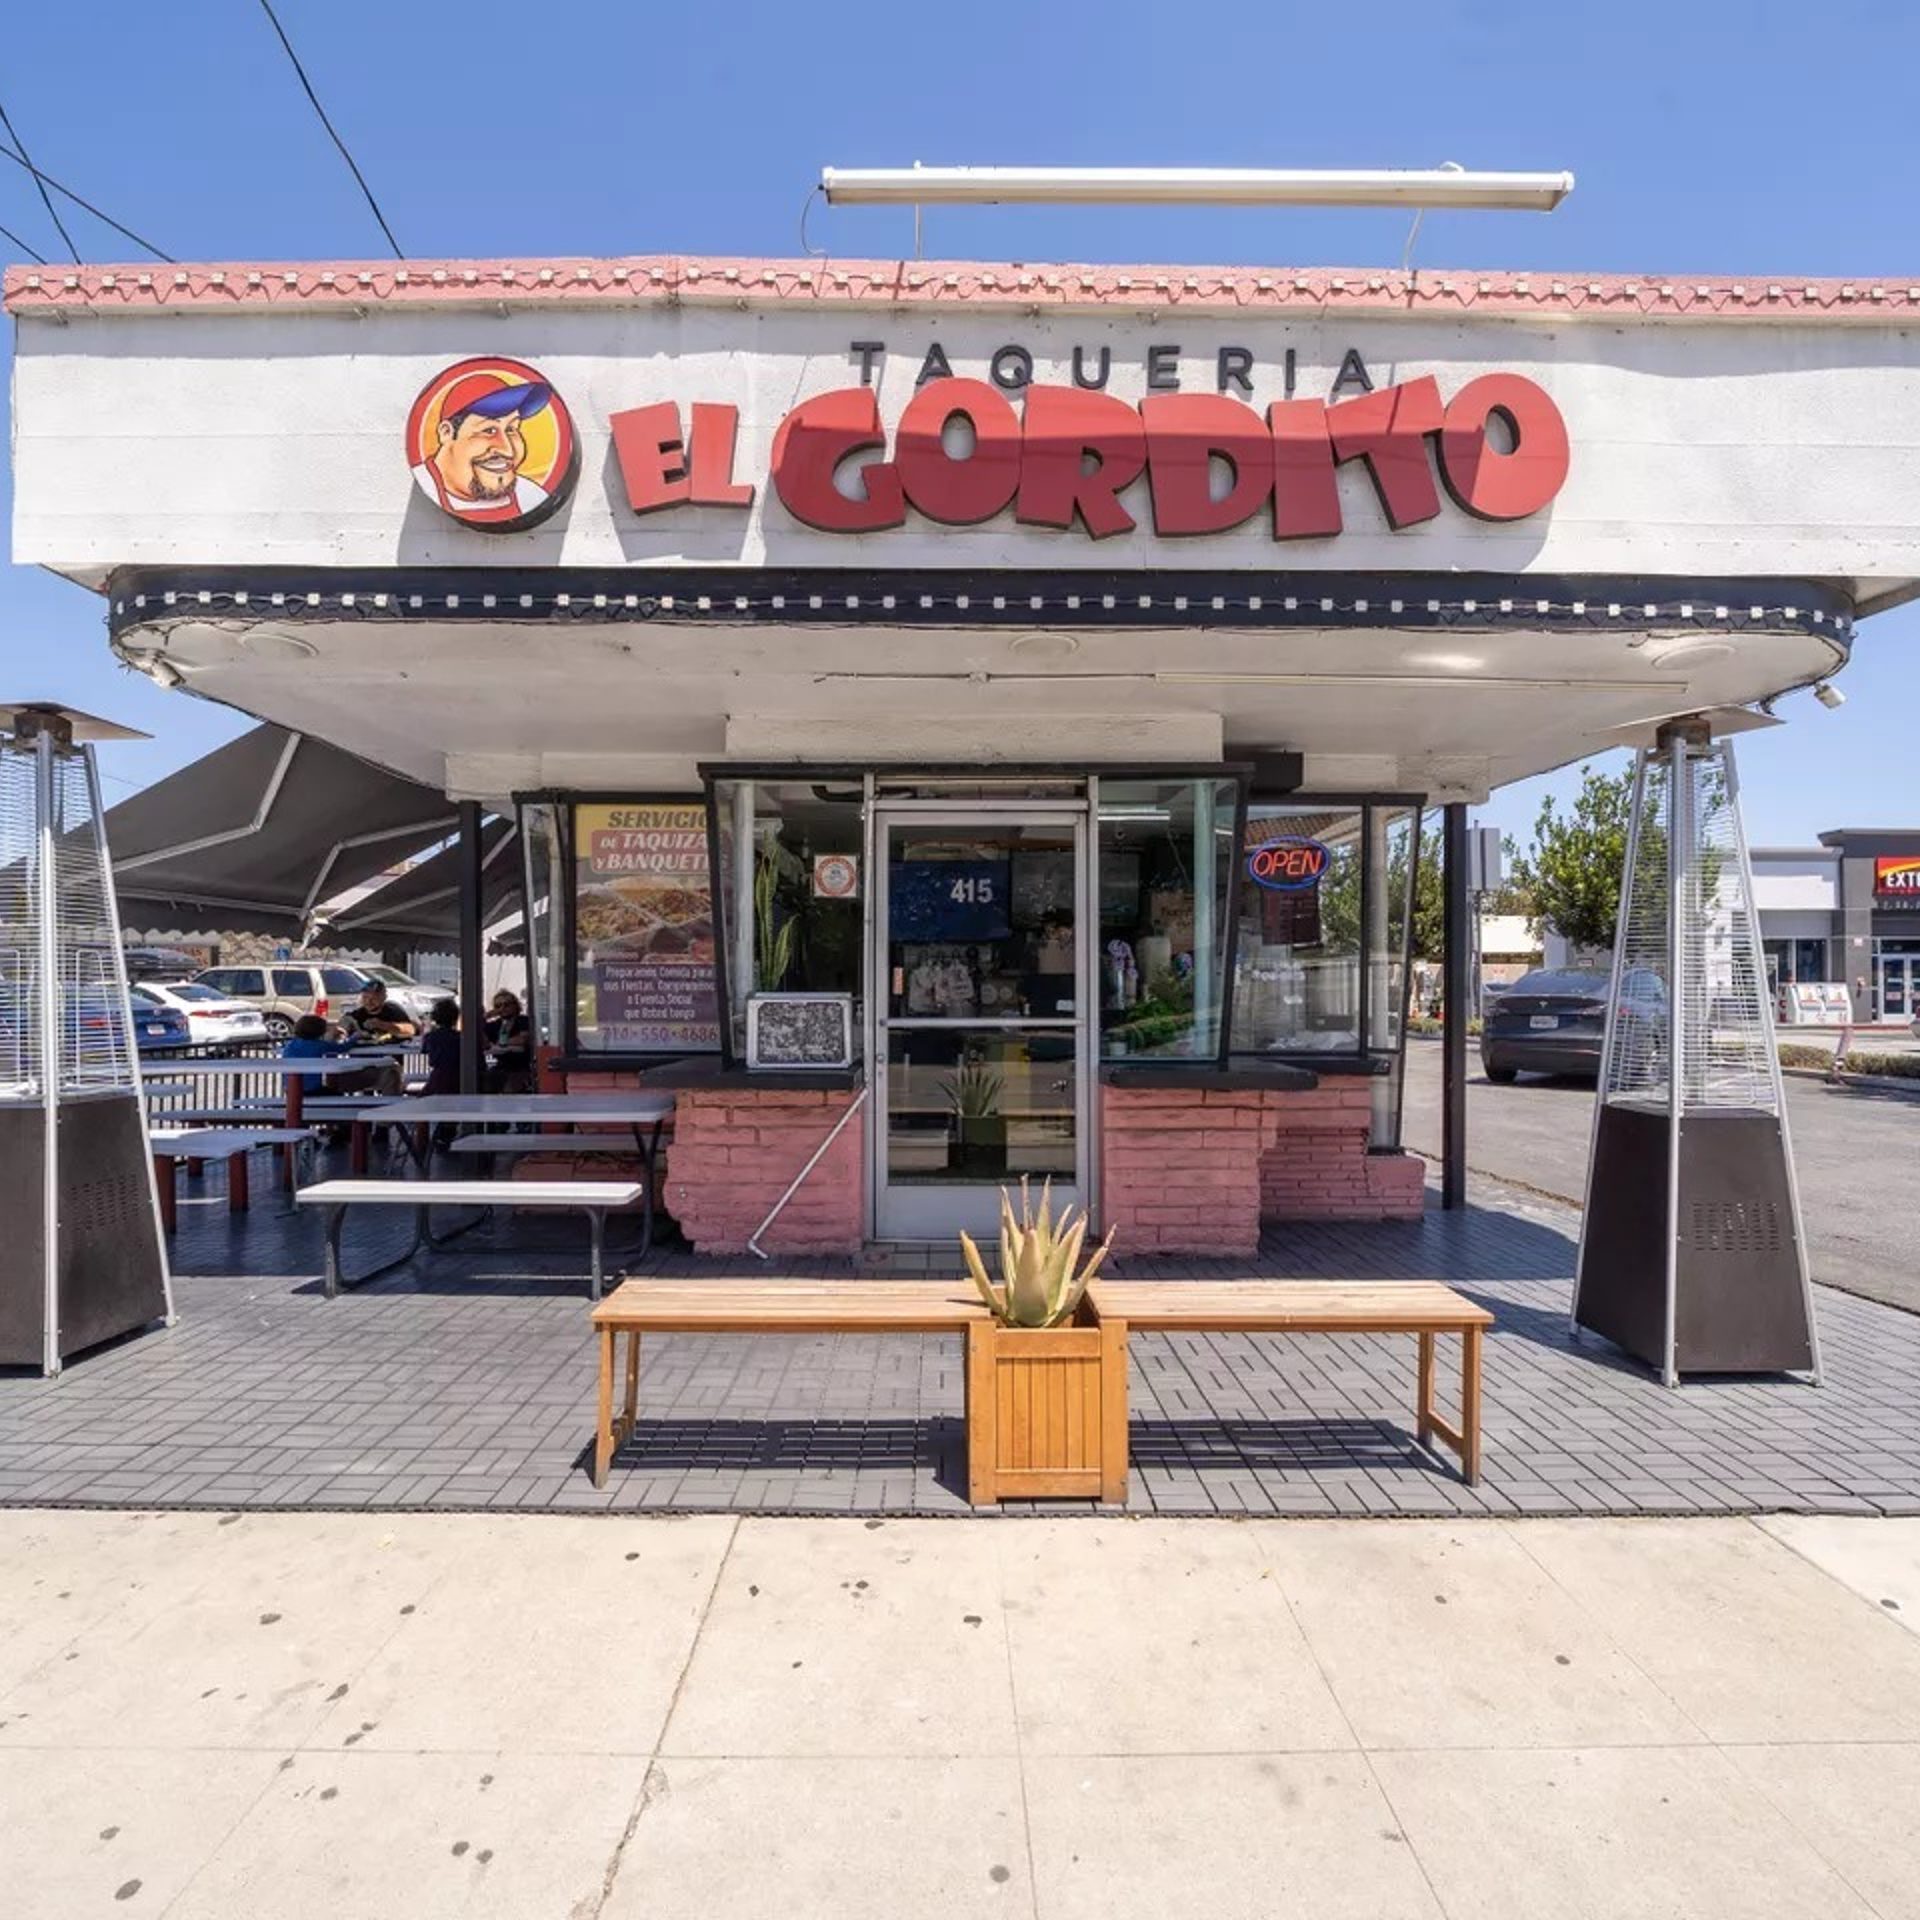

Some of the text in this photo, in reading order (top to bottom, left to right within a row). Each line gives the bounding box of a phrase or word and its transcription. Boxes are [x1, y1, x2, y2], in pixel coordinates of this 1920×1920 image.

[850, 341, 1373, 391] TAQUERIA
[609, 371, 1569, 542] EL GORDITO
[1253, 849, 1323, 877] OPEN
[950, 878, 993, 903] 415
[1886, 871, 1920, 888] EXT
